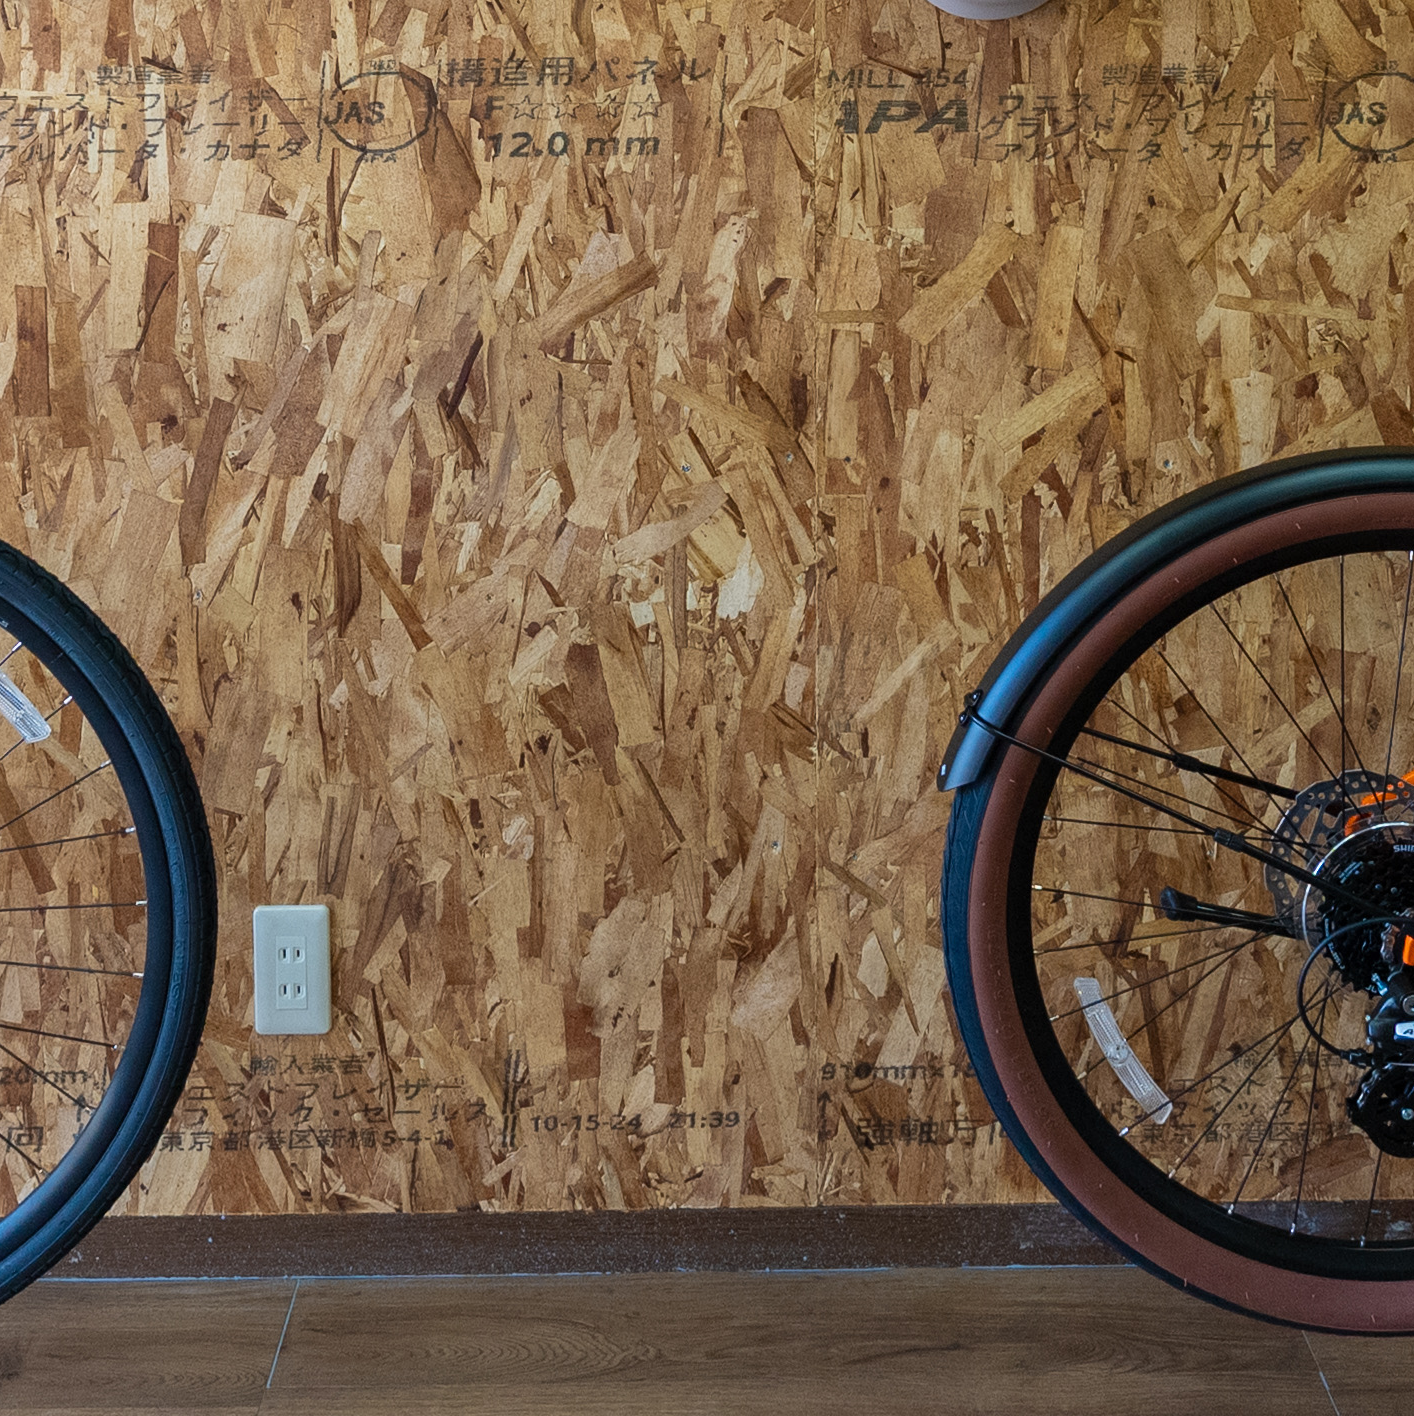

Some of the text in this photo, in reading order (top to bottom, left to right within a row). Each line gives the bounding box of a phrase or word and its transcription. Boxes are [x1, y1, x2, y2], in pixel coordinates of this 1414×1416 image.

[827, 69, 905, 89] MILL
[488, 131, 660, 158] 12.0 mm
